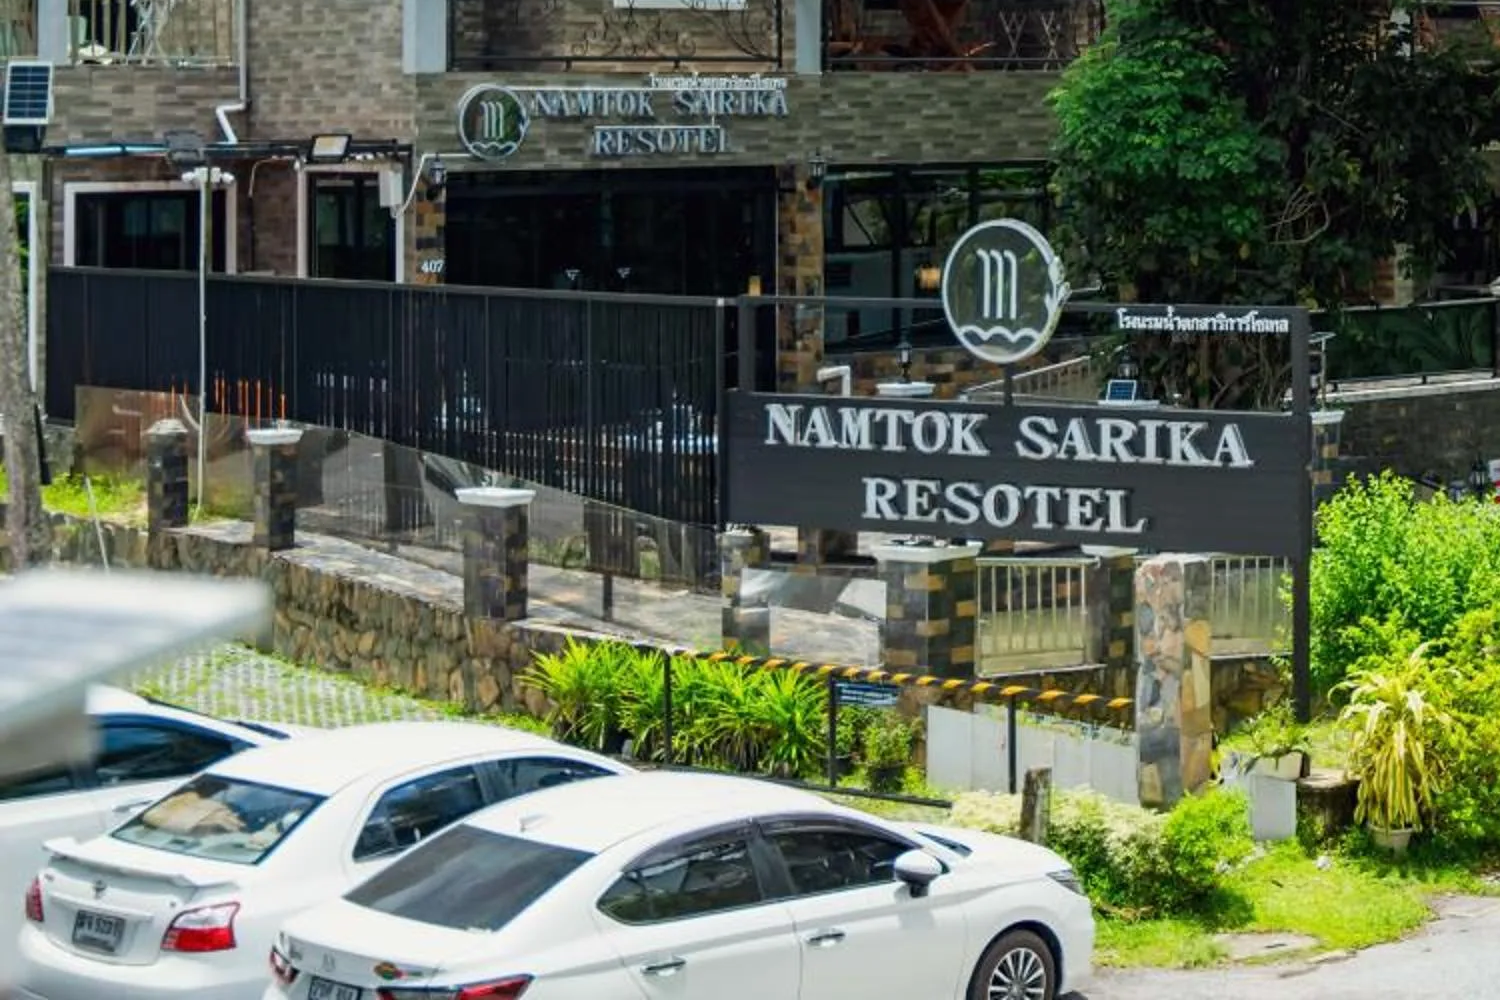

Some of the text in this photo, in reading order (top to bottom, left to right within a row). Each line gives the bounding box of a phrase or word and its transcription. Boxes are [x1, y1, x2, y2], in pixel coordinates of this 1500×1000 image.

[530, 88, 789, 117] NAMTOK SARIKA
[591, 127, 733, 154] RESOTEL
[421, 259, 445, 273] 407
[764, 402, 1255, 468] NAMTOK SARIKA
[861, 476, 1148, 534] RESOTEL
